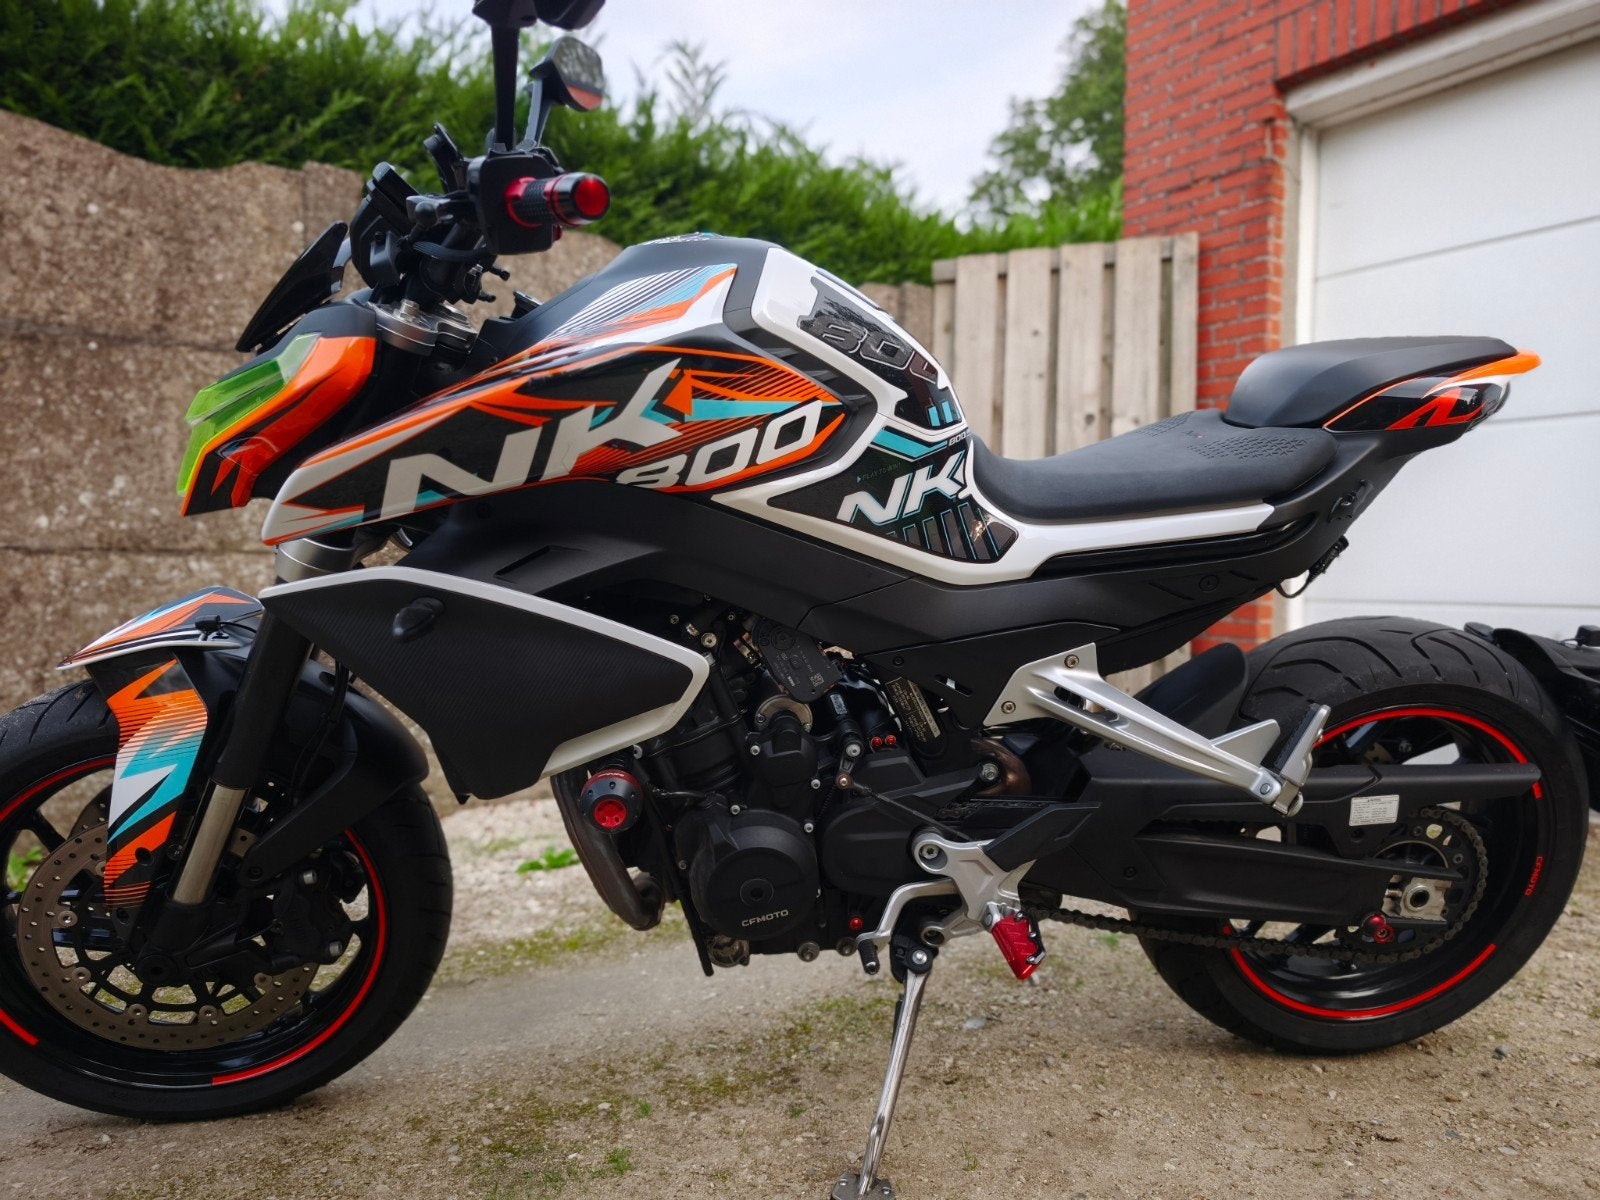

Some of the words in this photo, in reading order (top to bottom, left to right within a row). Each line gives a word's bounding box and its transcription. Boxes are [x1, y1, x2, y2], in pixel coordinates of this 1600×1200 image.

[380, 357, 683, 518] NK
[615, 399, 822, 490] 800
[836, 449, 966, 525] NK
[1525, 856, 1544, 896] CFMOTO
[741, 909, 789, 927] CFMOTO
